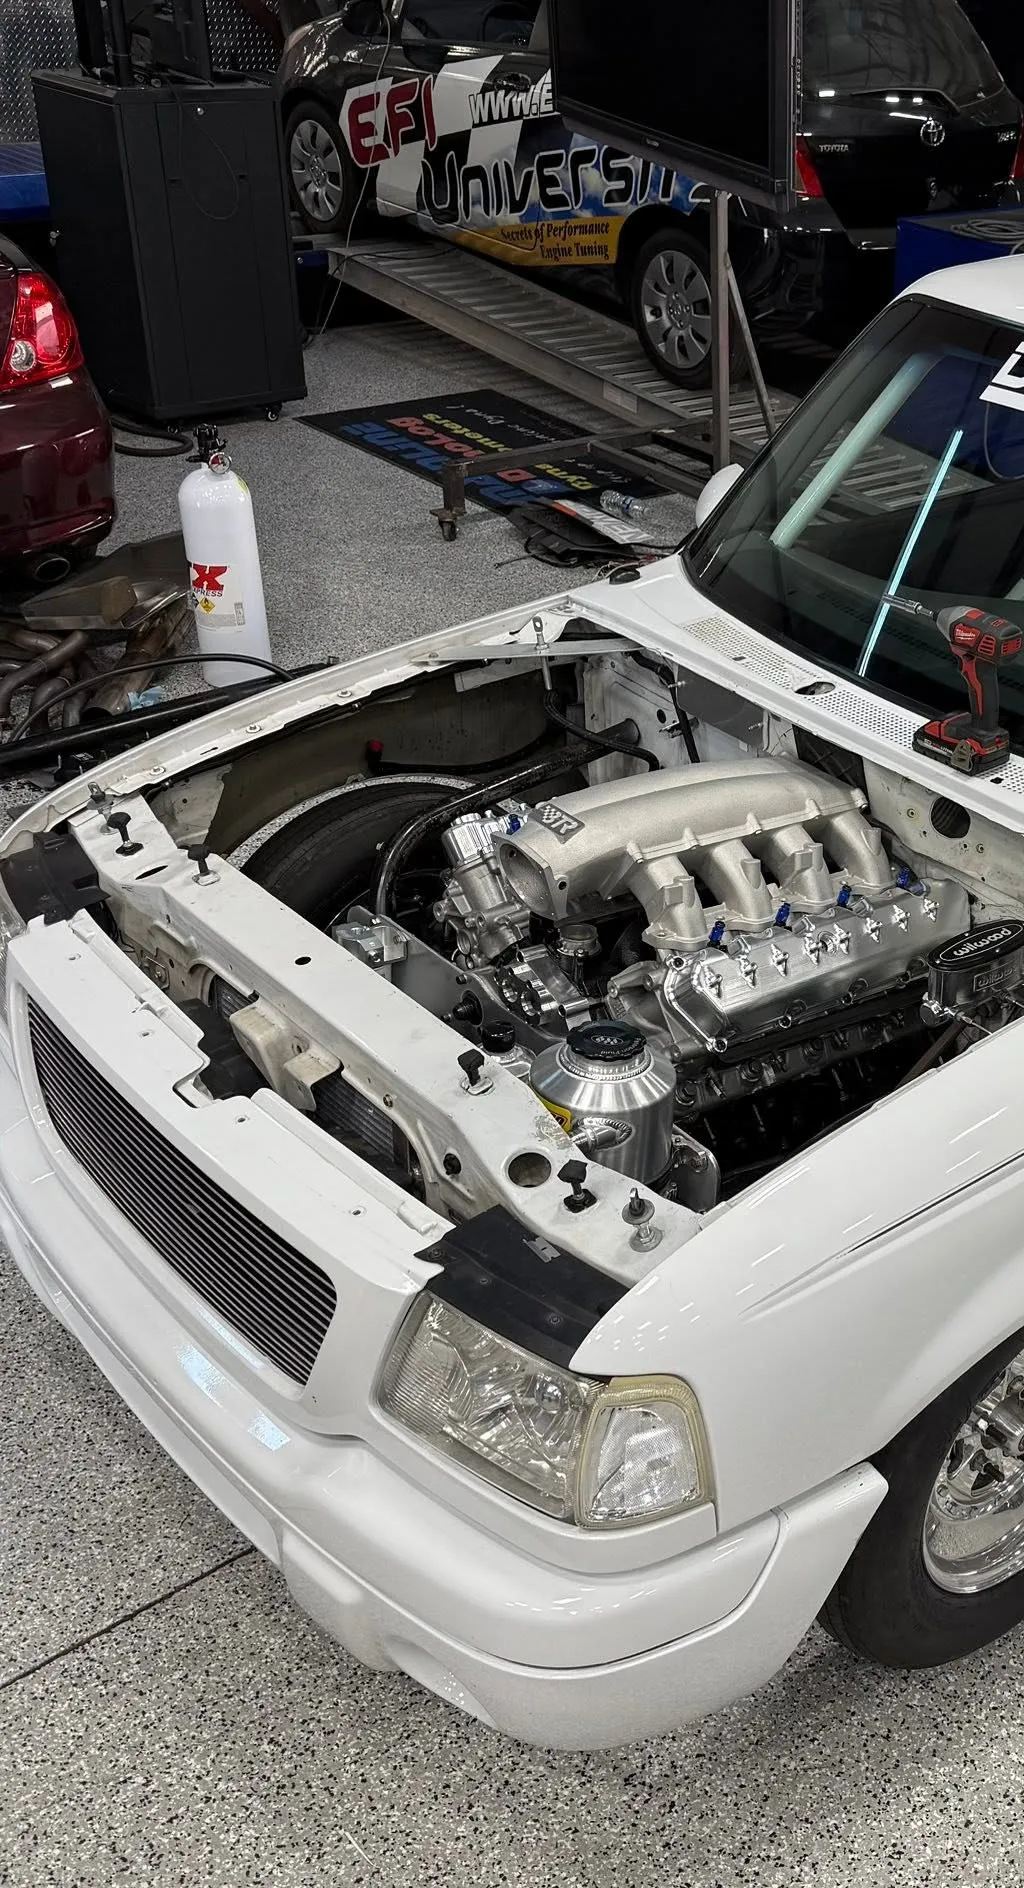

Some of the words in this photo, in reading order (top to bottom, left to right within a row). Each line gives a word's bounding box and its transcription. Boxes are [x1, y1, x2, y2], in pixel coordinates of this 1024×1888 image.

[348, 75, 437, 169] EFI
[819, 144, 849, 152] TOYOTA
[500, 224, 533, 243] Secrets
[534, 222, 545, 243] of
[547, 220, 610, 241] Performance
[540, 243, 573, 262] Engine
[573, 240, 610, 260] Tuning
[953, 927, 1012, 956] wilwood
